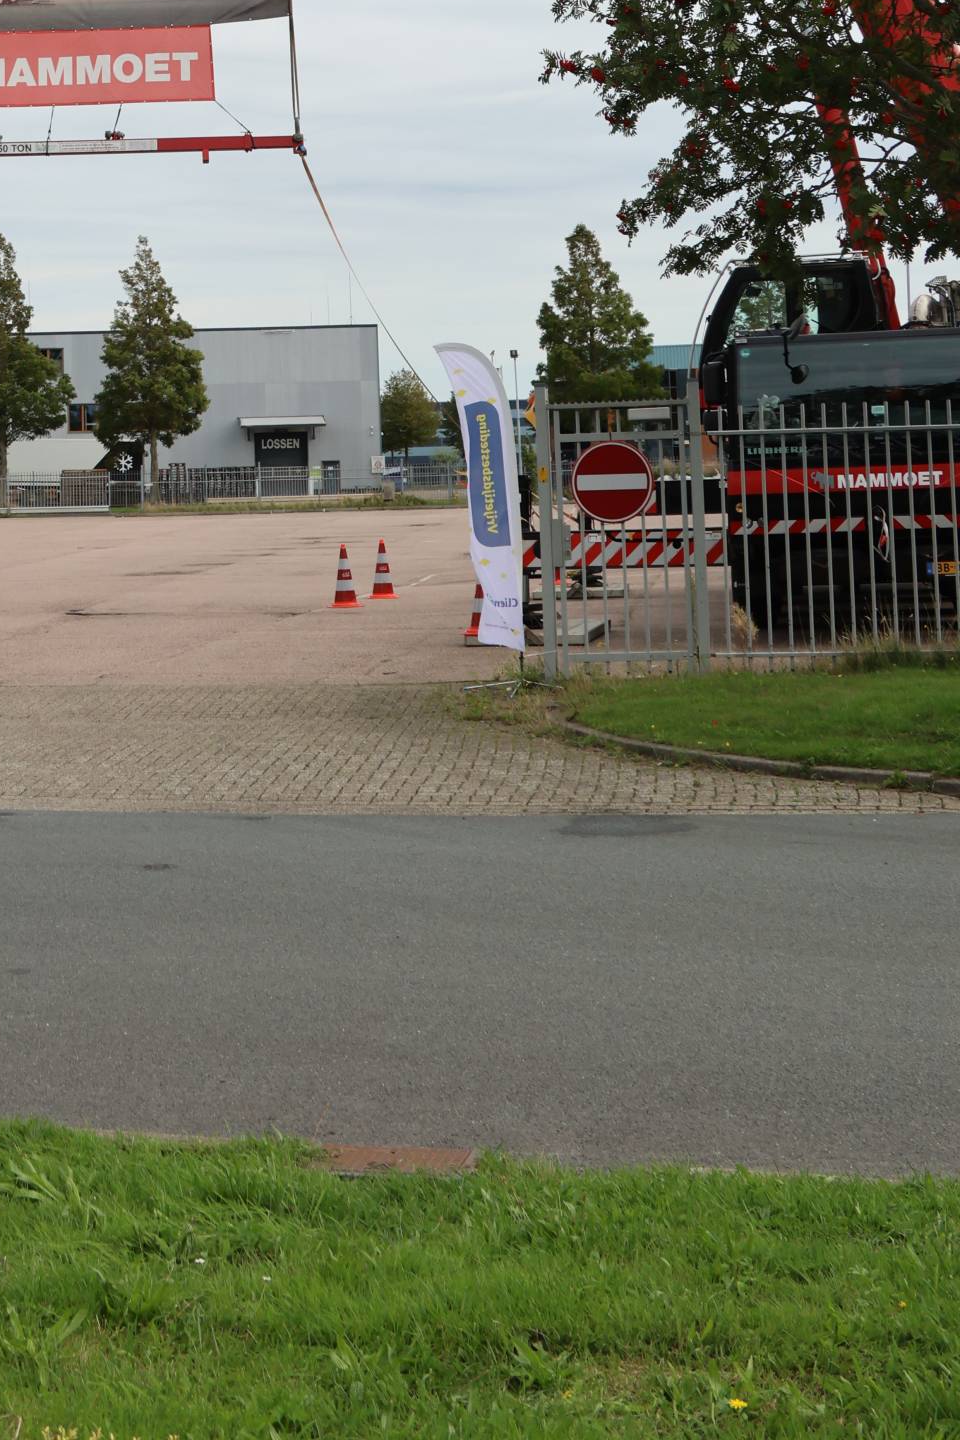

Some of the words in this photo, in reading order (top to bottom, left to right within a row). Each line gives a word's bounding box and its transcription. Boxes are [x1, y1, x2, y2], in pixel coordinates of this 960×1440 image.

[11, 143, 32, 152] TON
[261, 438, 300, 449] LOSSEN
[837, 471, 943, 489] MAMMOET
